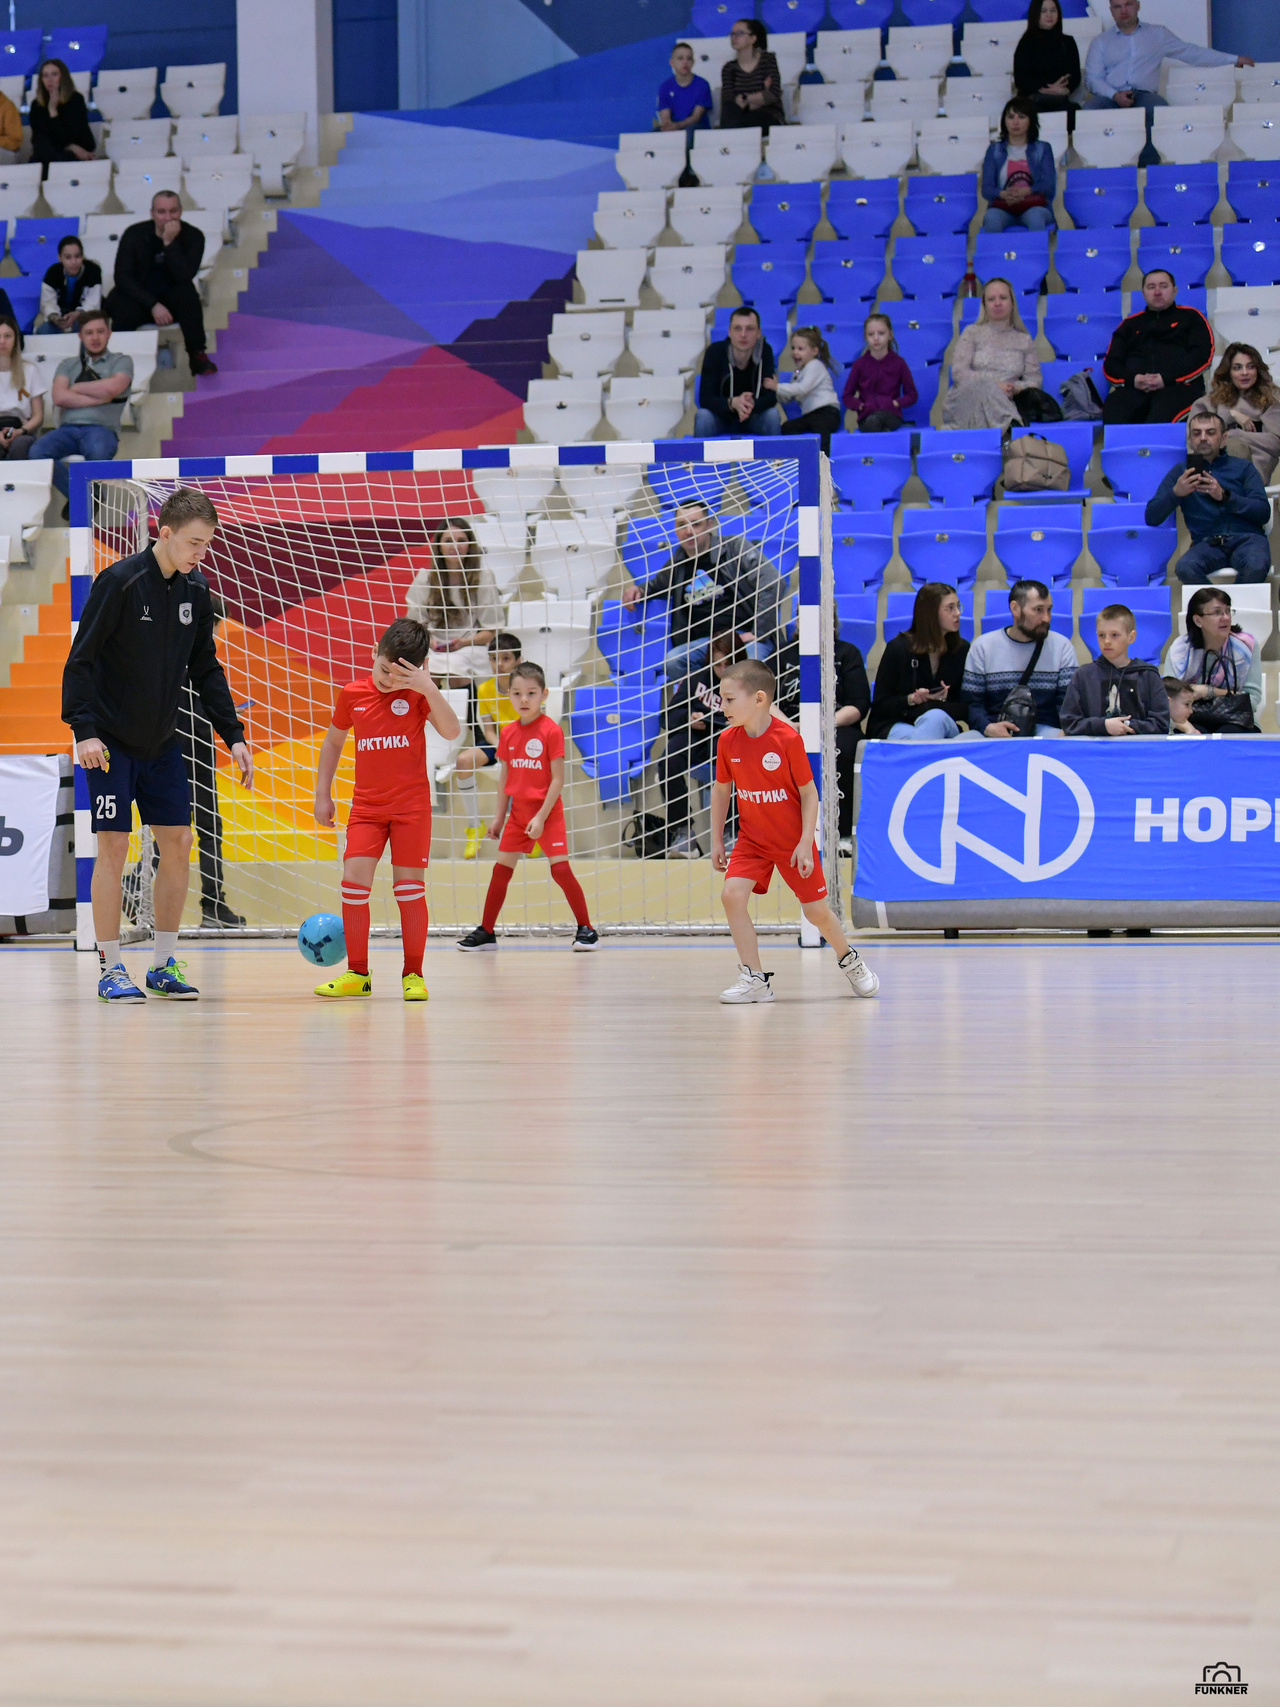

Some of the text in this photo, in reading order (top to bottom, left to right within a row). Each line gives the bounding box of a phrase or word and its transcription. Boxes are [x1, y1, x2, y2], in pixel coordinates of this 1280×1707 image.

[357, 735, 410, 752] АРКТИКА
[510, 758, 542, 770] КТИКА
[96, 795, 117, 819] 25
